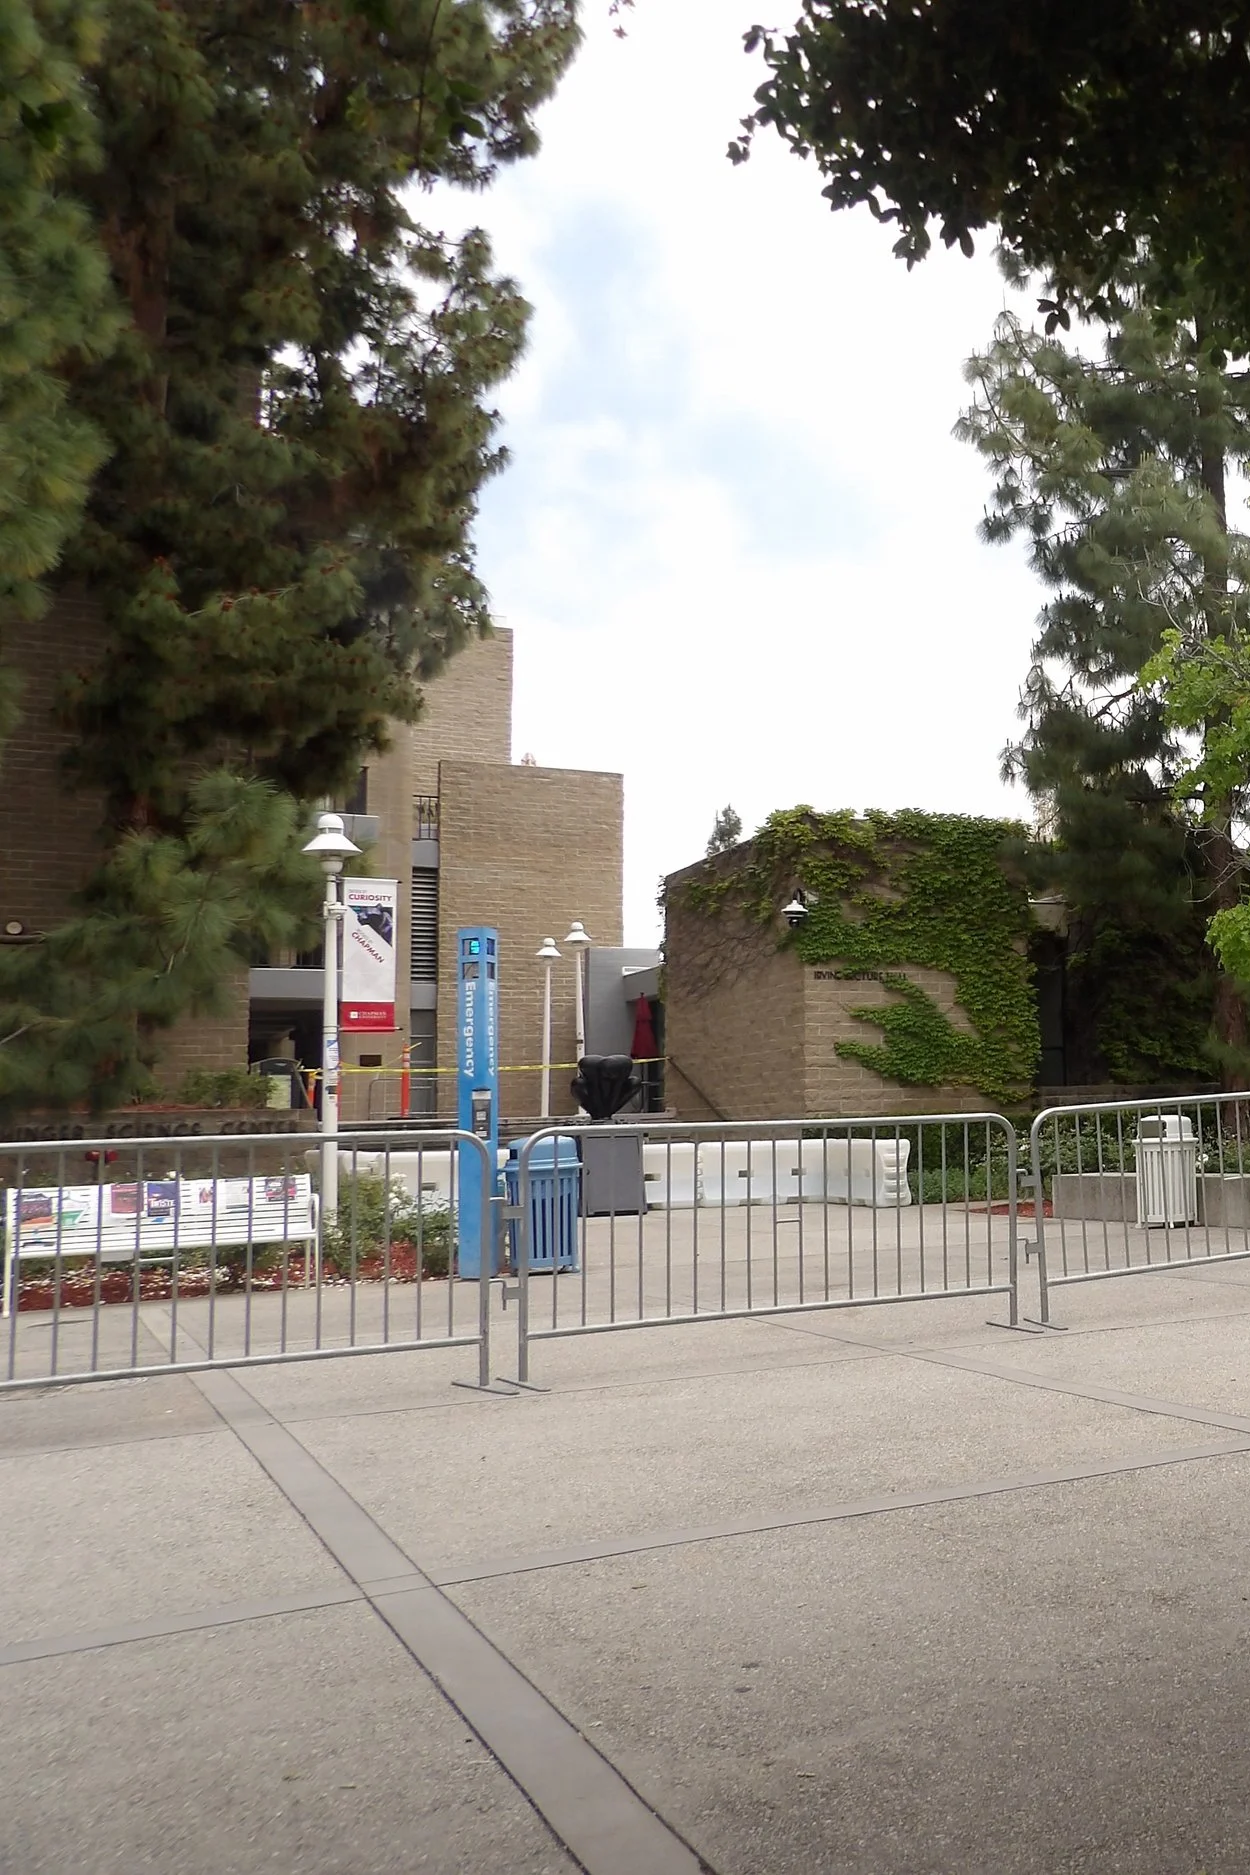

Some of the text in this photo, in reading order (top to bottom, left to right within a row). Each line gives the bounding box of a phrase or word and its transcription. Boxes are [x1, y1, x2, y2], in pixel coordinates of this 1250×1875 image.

[348, 893, 392, 901] CURIOSITY
[352, 931, 385, 963] CHAPMAN
[843, 971, 883, 981] CTURE
[463, 981, 476, 1078] Emergency
[487, 981, 495, 1077] Emergency
[107, 1121, 201, 1139] SCIENCE
